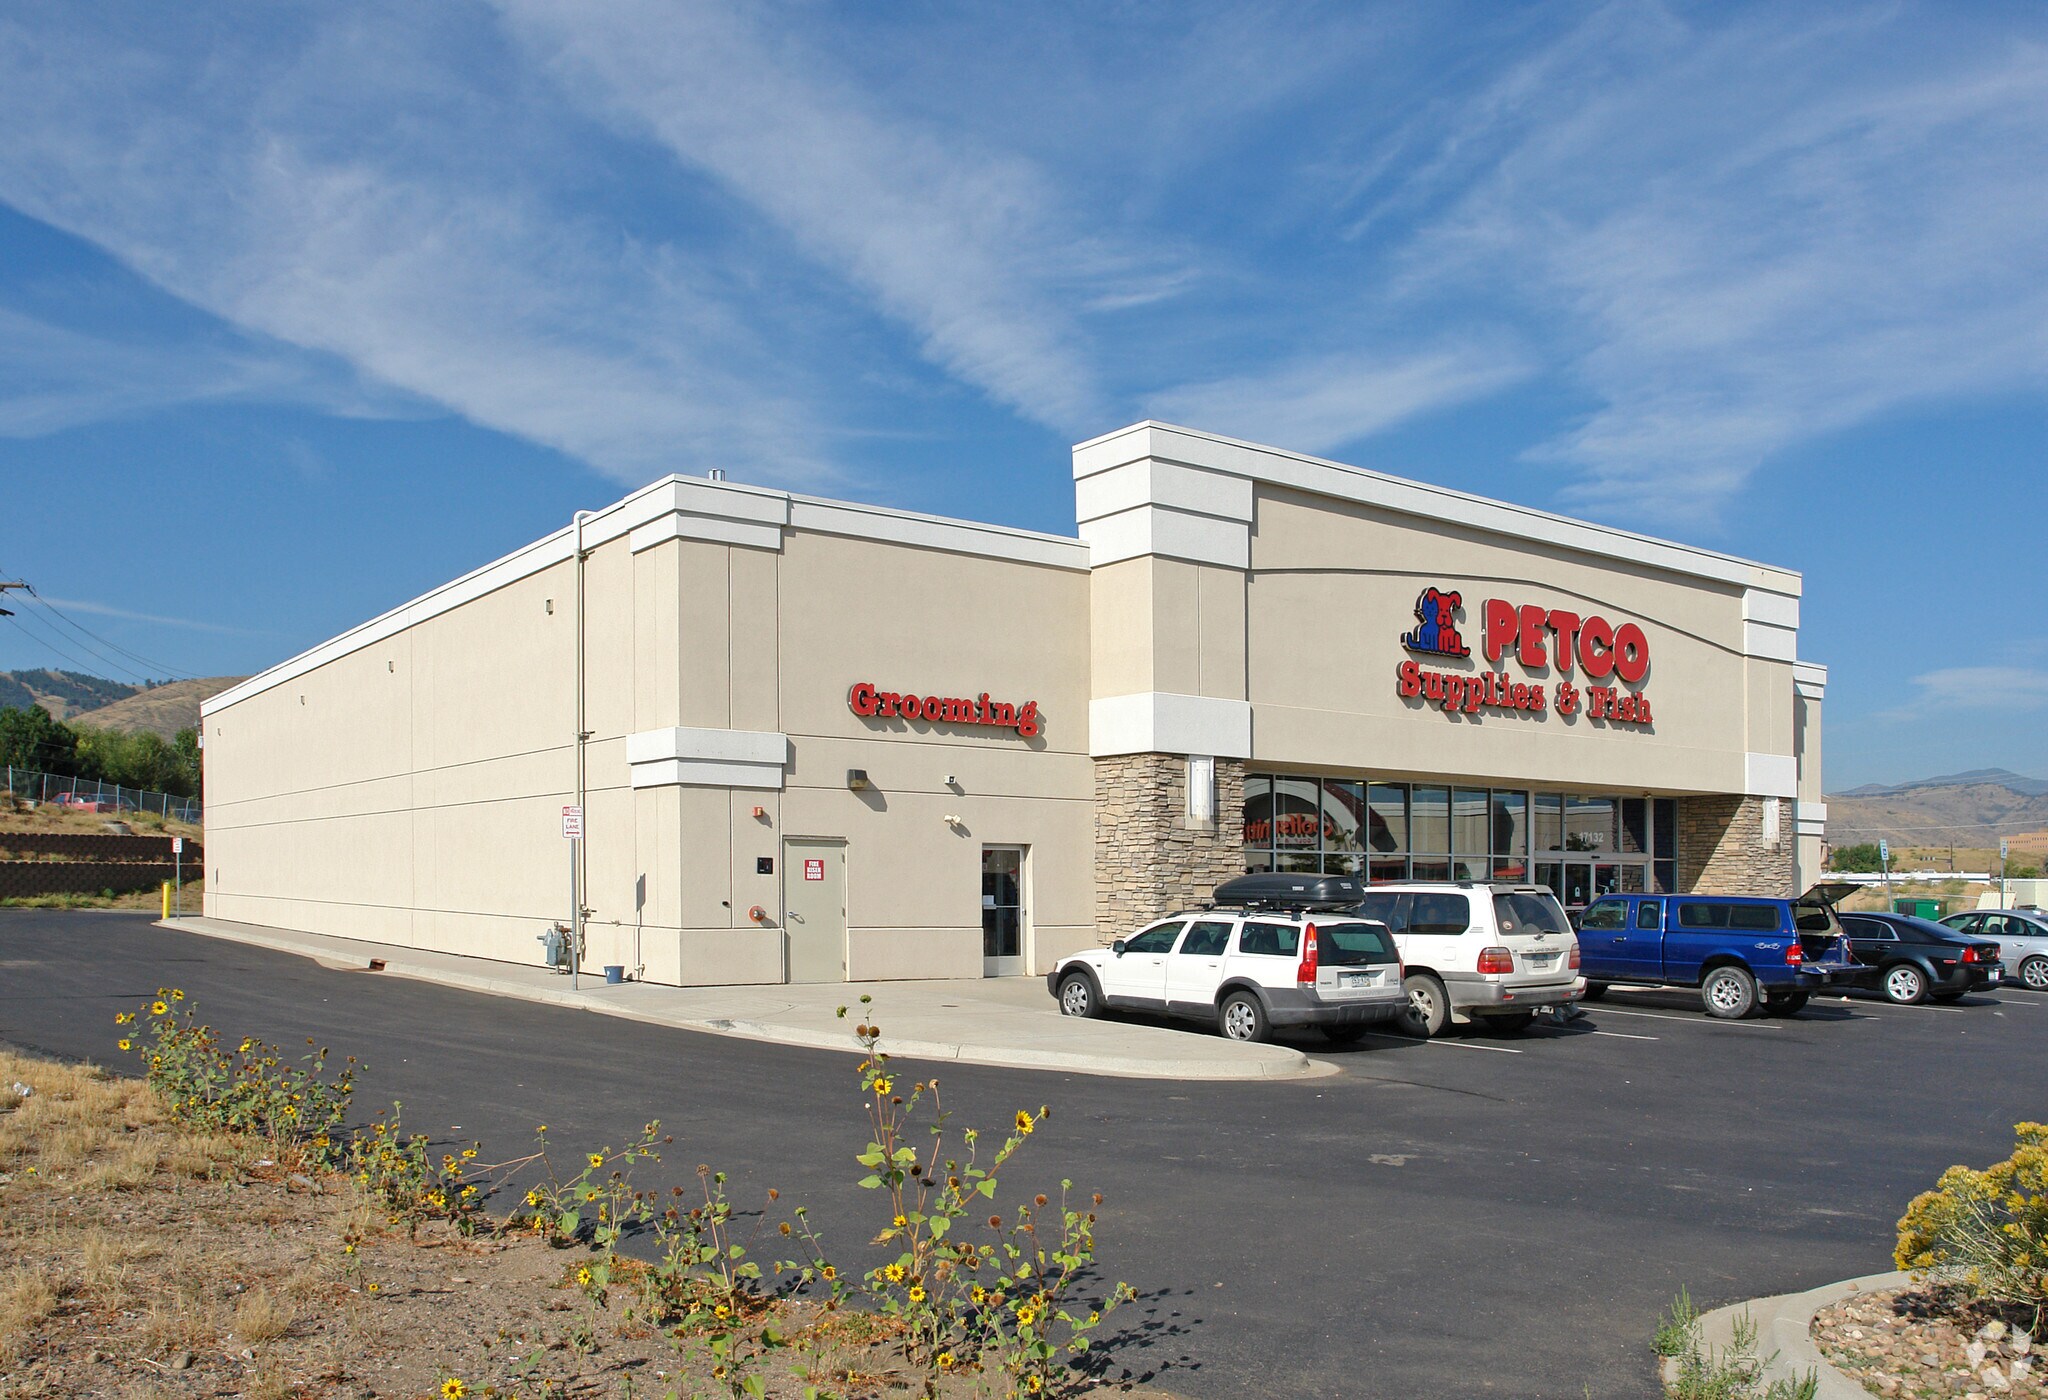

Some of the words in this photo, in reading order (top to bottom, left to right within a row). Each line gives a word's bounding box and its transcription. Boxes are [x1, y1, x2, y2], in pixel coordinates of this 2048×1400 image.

[1482, 598, 1650, 683] PETCO
[848, 682, 1039, 737] Grooming
[1396, 660, 1546, 713] Supplies
[1556, 681, 1579, 715] &
[1586, 685, 1654, 724] Fish
[1579, 831, 1604, 843] 17132
